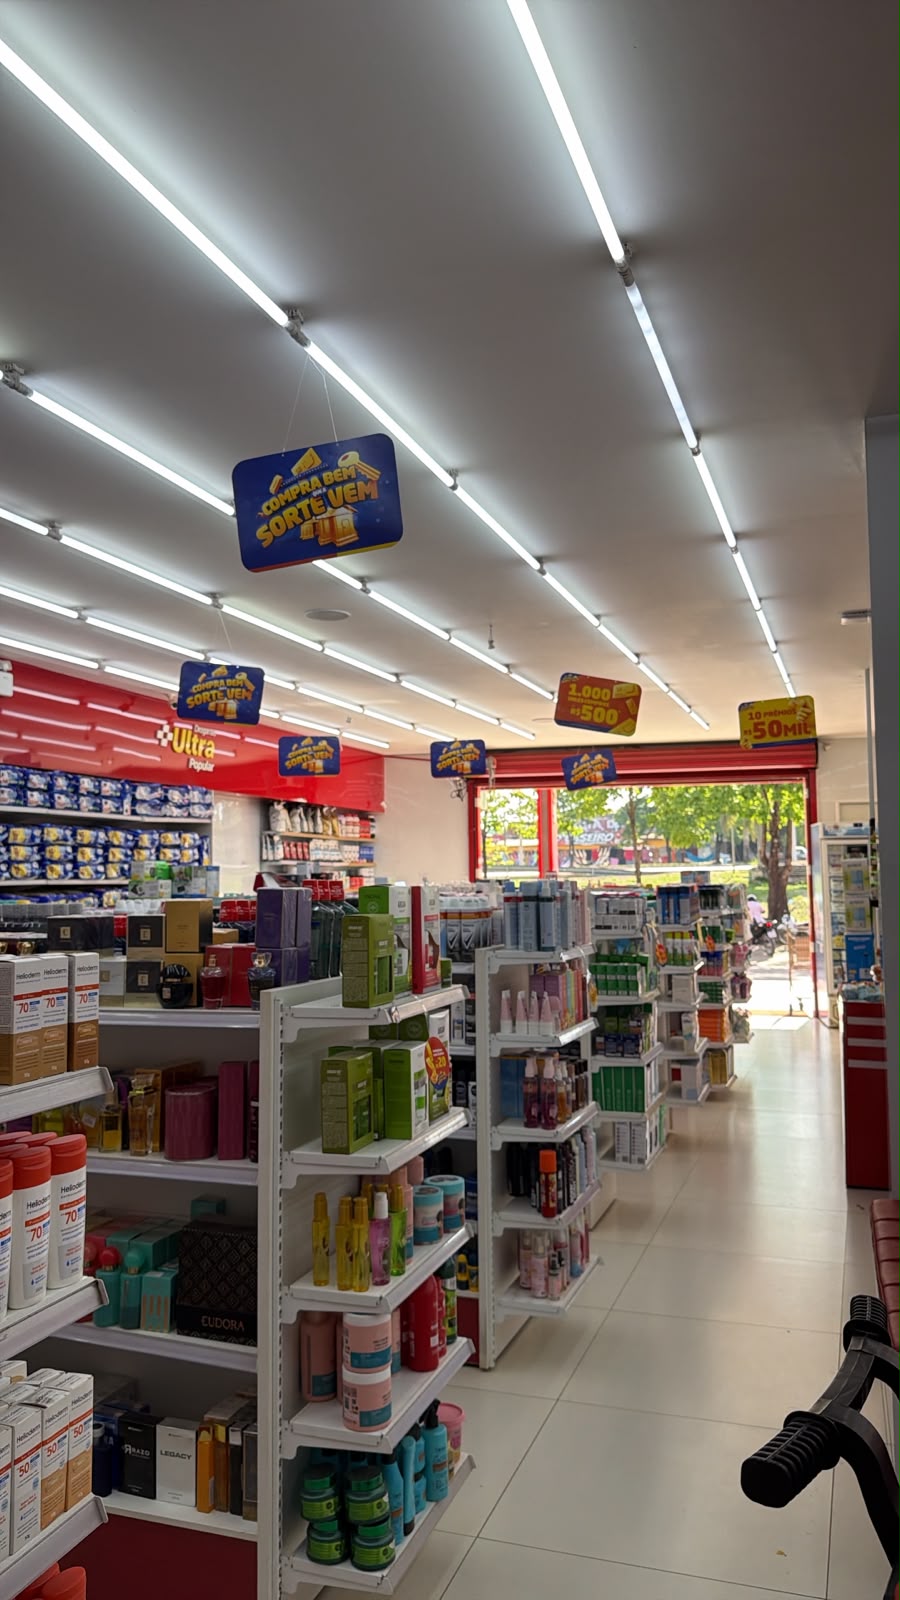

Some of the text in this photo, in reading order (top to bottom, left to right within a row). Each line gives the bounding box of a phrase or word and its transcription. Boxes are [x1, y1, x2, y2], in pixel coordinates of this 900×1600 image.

[262, 476, 321, 516] COMPRA
[323, 465, 358, 486] BEM
[256, 481, 380, 548] SORTE VEM
[192, 678, 244, 693] COMPRA BEM
[568, 683, 611, 701] 1.000
[186, 688, 252, 709] SORTE VEM
[748, 711, 761, 720] 10
[172, 727, 215, 759] Ultra
[188, 757, 215, 773] Popular
[46, 997, 56, 1008] 70
[79, 993, 88, 1004] 70
[18, 1002, 29, 1014] 70
[65, 1208, 77, 1225] 70
[30, 1225, 43, 1242] 70
[201, 1315, 245, 1331] EUDORA
[73, 1423, 84, 1439] 50
[46, 1442, 57, 1458] 50
[160, 1449, 192, 1461] LEGACY
[18, 1462, 30, 1479] 50
